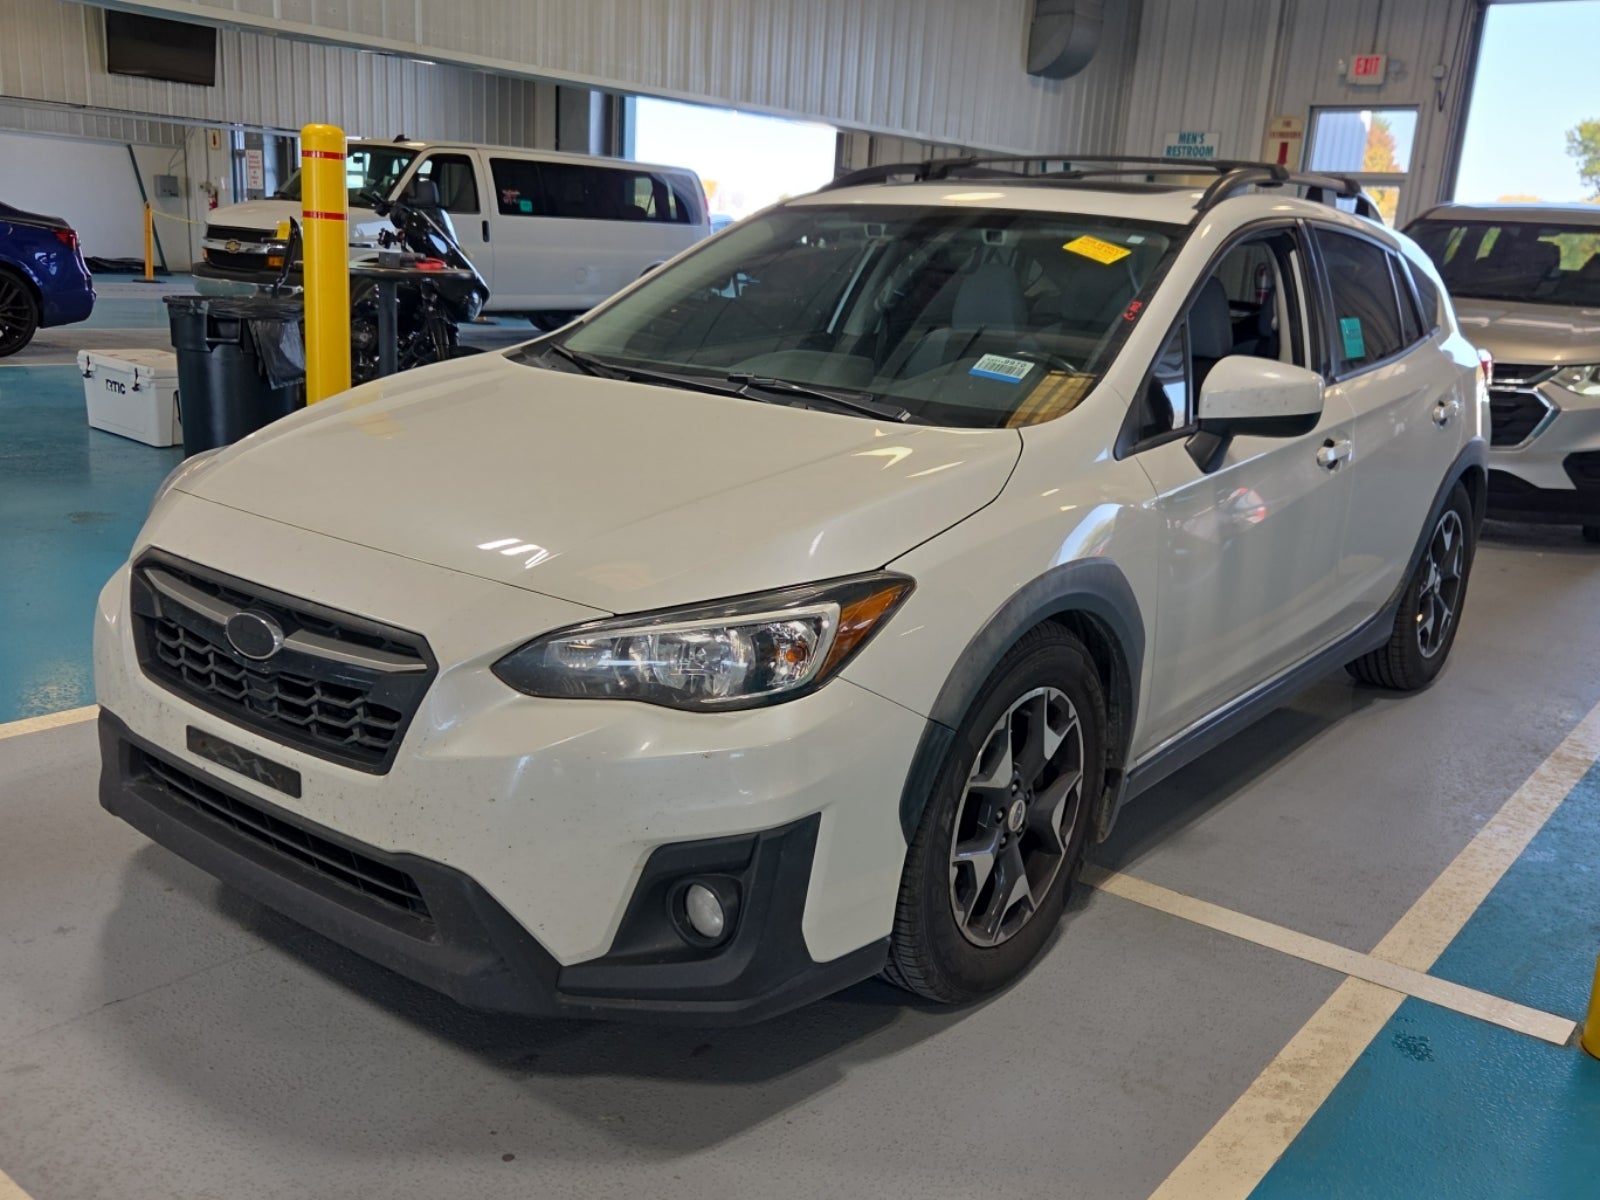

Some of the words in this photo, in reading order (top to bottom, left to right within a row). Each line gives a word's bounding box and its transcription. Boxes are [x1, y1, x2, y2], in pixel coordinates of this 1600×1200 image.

[1354, 56, 1381, 76] EXIT
[1178, 132, 1205, 145] MEN'S
[1165, 145, 1214, 158] RESTROOM
